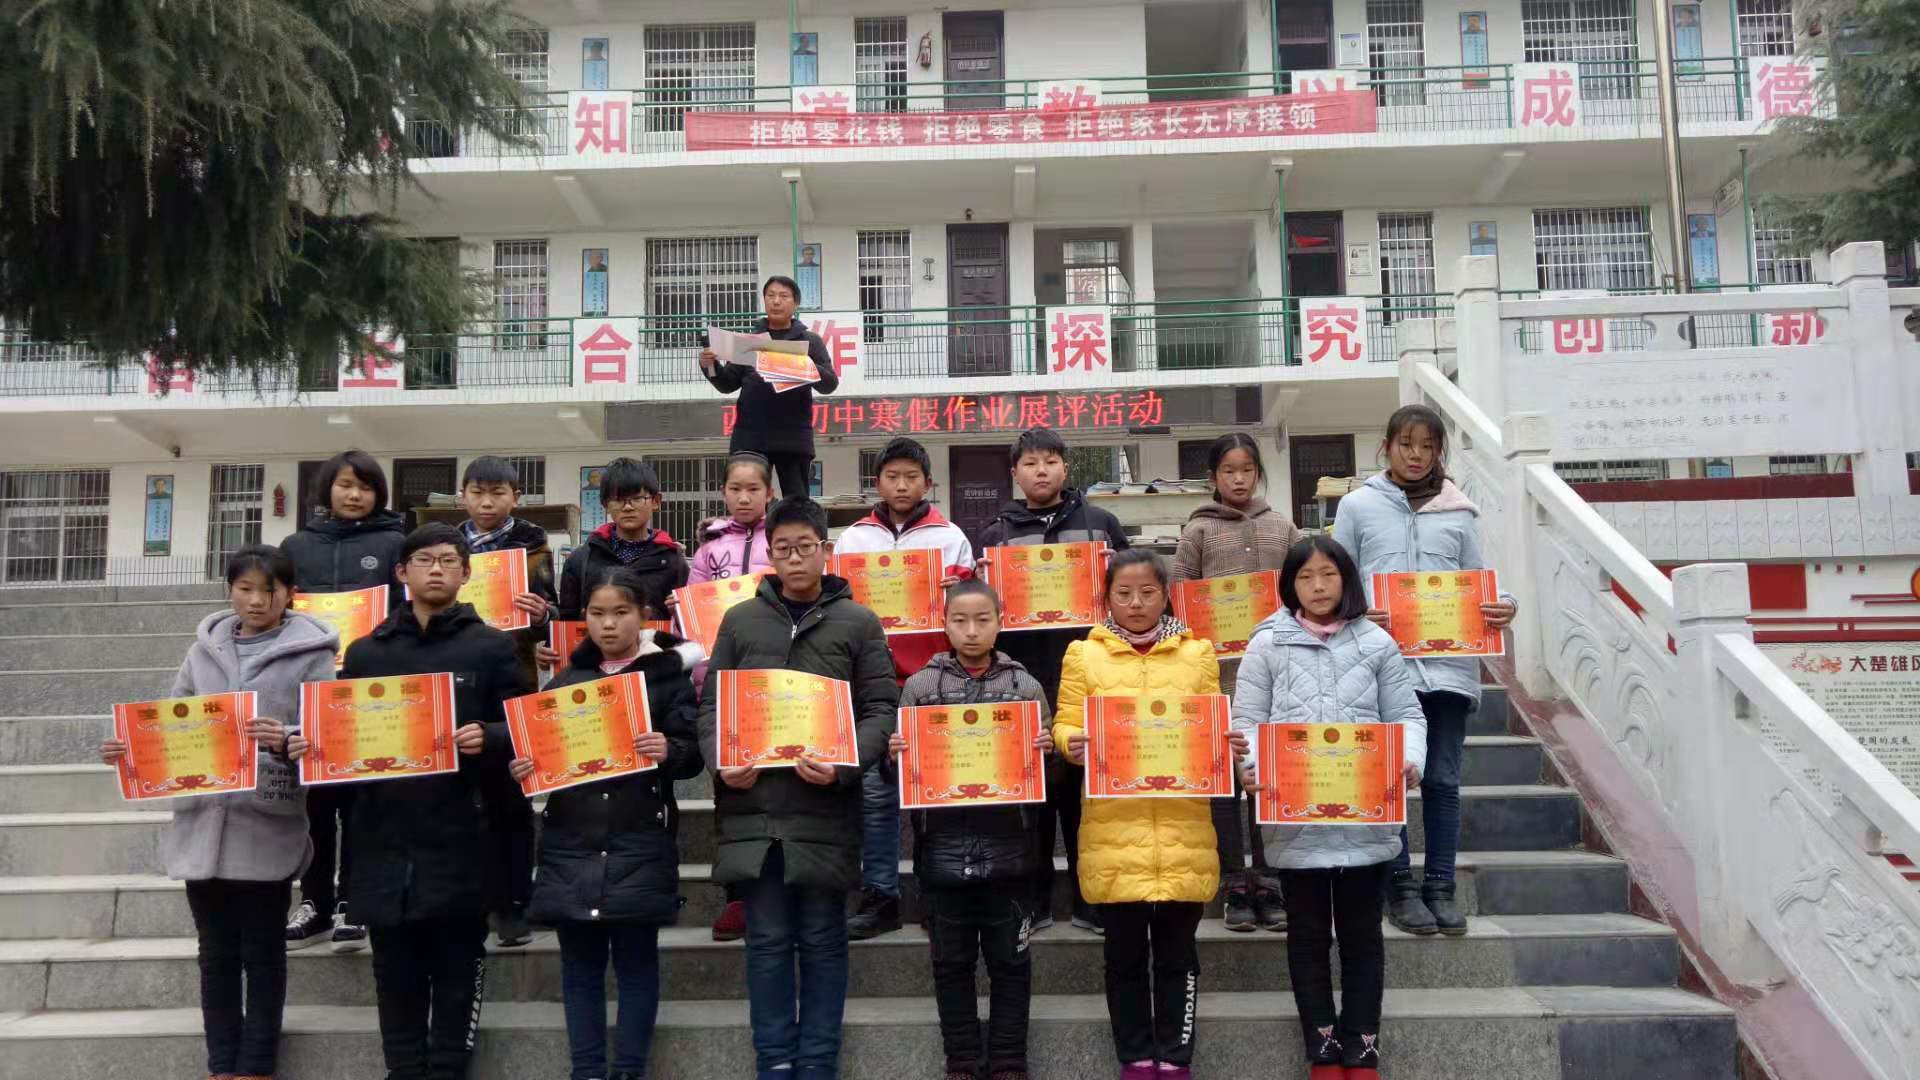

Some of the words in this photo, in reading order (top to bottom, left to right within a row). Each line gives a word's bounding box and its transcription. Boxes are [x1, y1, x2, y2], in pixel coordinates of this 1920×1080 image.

[575, 96, 628, 153] 知
[1521, 70, 1576, 126] 成
[1757, 62, 1813, 119] 德
[749, 115, 905, 147] 拒绝零花钱
[923, 112, 1045, 144] 拒绝零食
[1064, 102, 1317, 140] 拒绝家长无序接领
[578, 323, 633, 384] 合
[811, 319, 859, 378] 作
[1051, 312, 1107, 373] 探
[1306, 303, 1362, 363] 究
